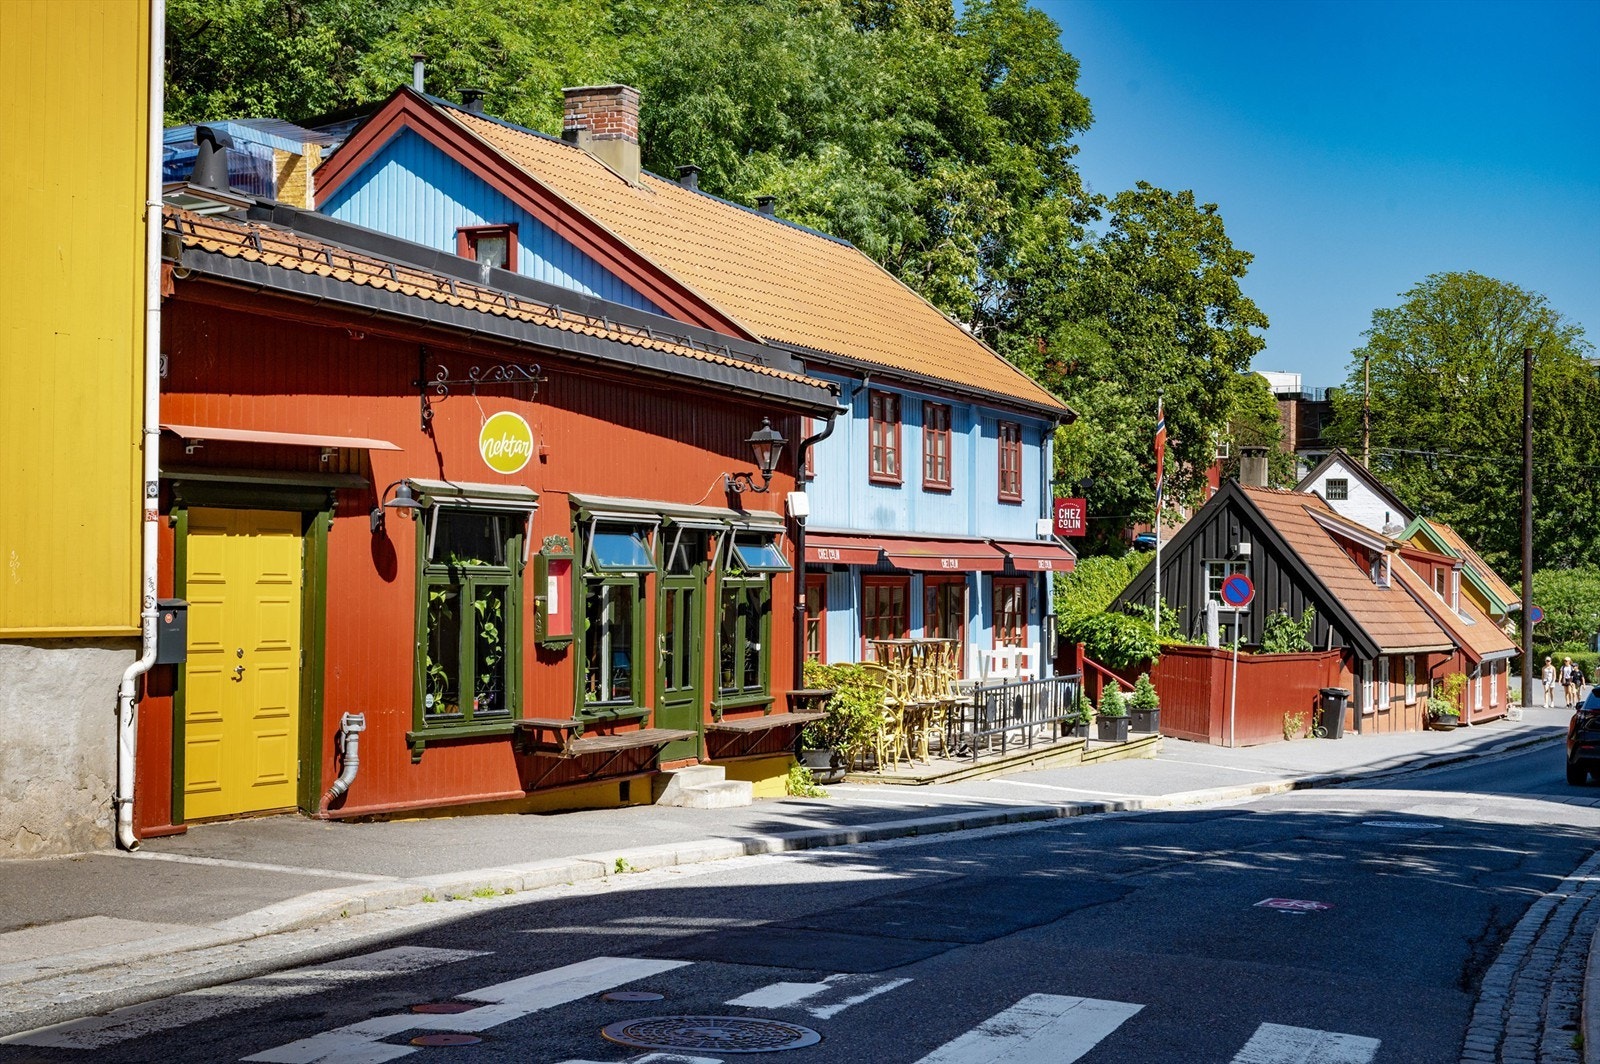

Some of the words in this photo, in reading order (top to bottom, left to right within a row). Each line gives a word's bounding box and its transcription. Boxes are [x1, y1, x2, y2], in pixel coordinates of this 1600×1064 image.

[482, 431, 531, 458] nektar
[1058, 508, 1081, 519] CHEZ
[1058, 519, 1081, 529] COLIN
